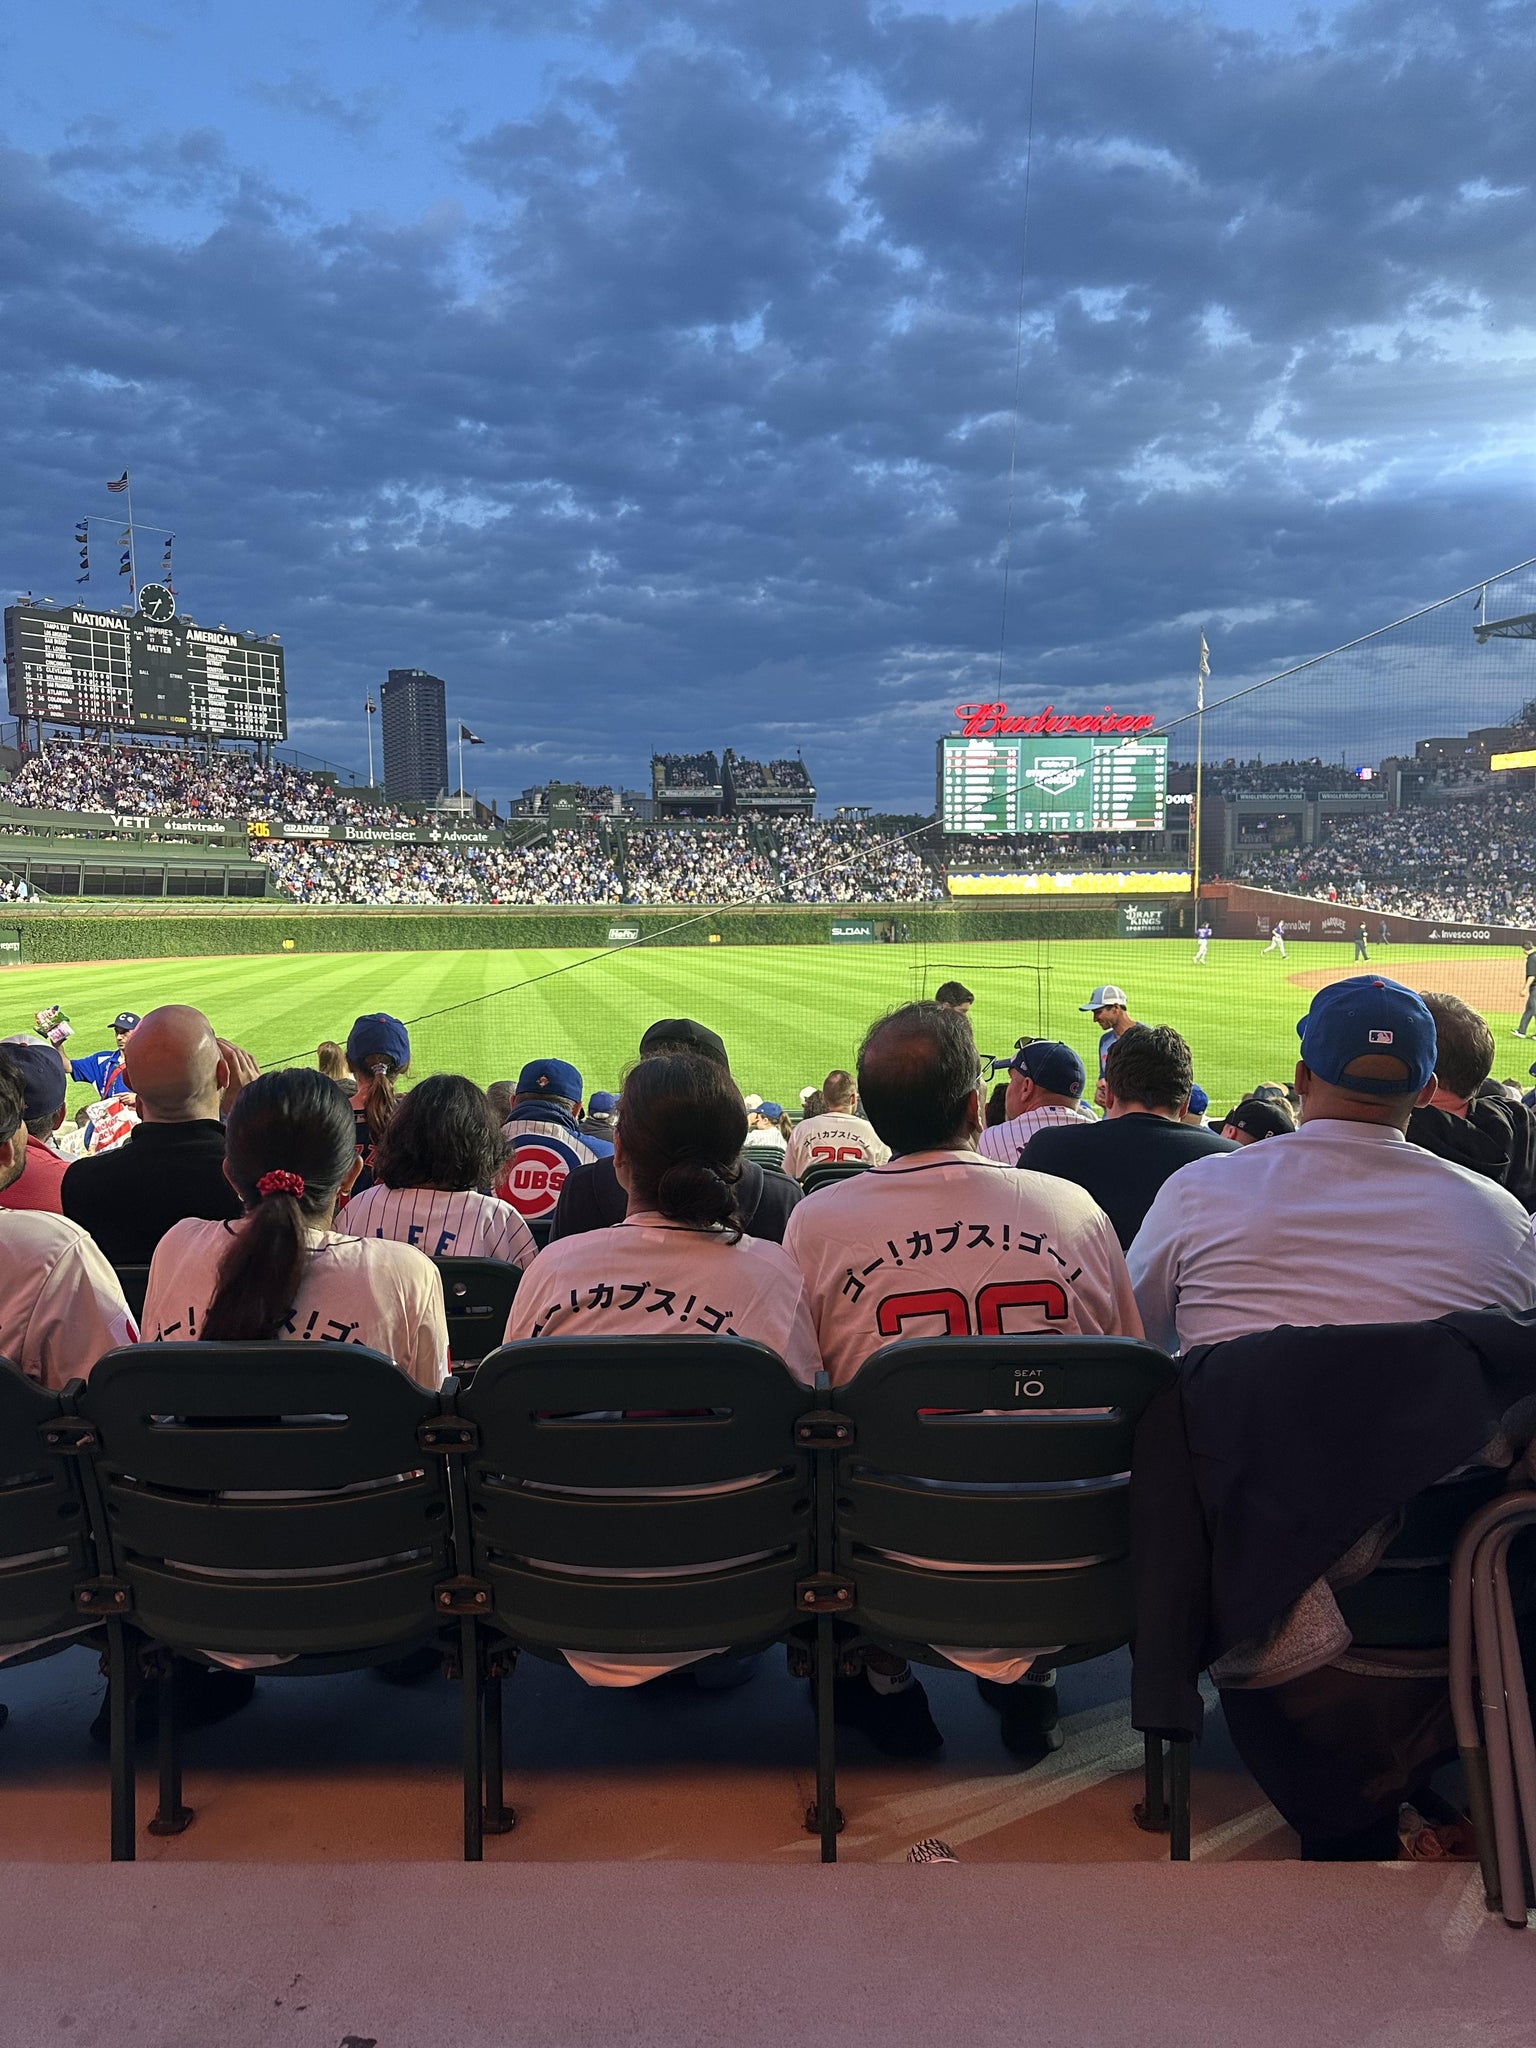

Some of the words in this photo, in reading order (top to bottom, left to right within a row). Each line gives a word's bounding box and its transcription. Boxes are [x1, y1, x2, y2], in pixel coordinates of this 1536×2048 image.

[73, 611, 131, 631] NATIONAL
[144, 625, 173, 637] UMPIRES
[186, 629, 237, 647] AMERICAN
[146, 644, 172, 655] BATTER
[955, 702, 1155, 738] Budweiser
[110, 815, 150, 829] YETI
[247, 822, 270, 837] 2:06
[283, 823, 330, 834] GRAINGER
[443, 831, 488, 842] Advocate
[1126, 910, 1162, 920] DRAFT
[1130, 918, 1161, 926] KINGS
[1321, 916, 1346, 930] MARQUEE
[610, 929, 637, 939] Hefty
[1441, 929, 1471, 939] Invesco
[1472, 930, 1490, 939] QQQ
[1014, 1369, 1043, 1377] SEAT
[1014, 1380, 1045, 1397] 10
